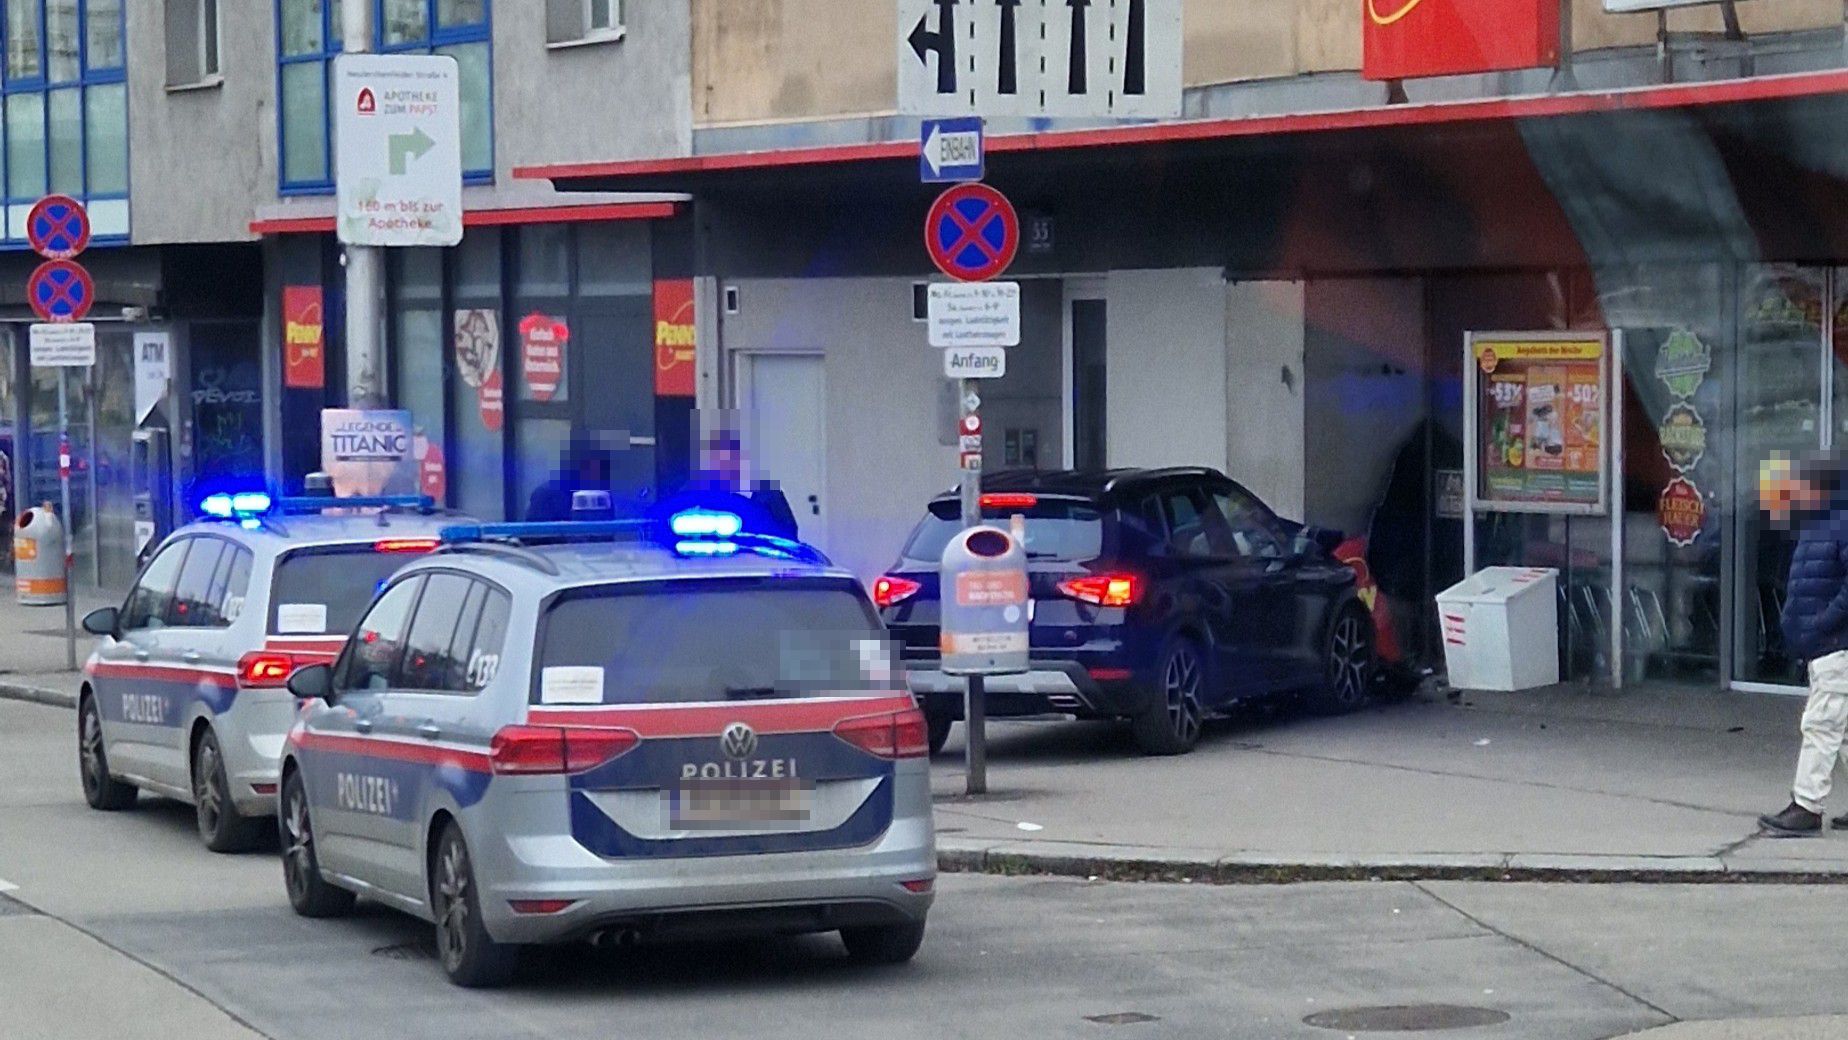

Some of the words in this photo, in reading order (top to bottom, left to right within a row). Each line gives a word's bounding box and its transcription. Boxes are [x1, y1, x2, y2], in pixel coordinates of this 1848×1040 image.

[384, 91, 437, 101] APOTHEKE
[384, 103, 406, 114] ZUM
[408, 103, 438, 116] PAPST
[384, 203, 397, 212] m
[400, 200, 419, 212] bis
[423, 203, 445, 213] zur
[368, 216, 433, 229] Apotheke
[142, 342, 165, 362] ATM
[951, 353, 999, 371] Anfang
[342, 421, 393, 432] LEGENDE
[331, 434, 407, 453] TITANIC
[474, 653, 499, 687] 133
[122, 693, 164, 722] POLIZEI
[682, 758, 797, 777] POLIZEI
[337, 772, 391, 815] POLIZEI
